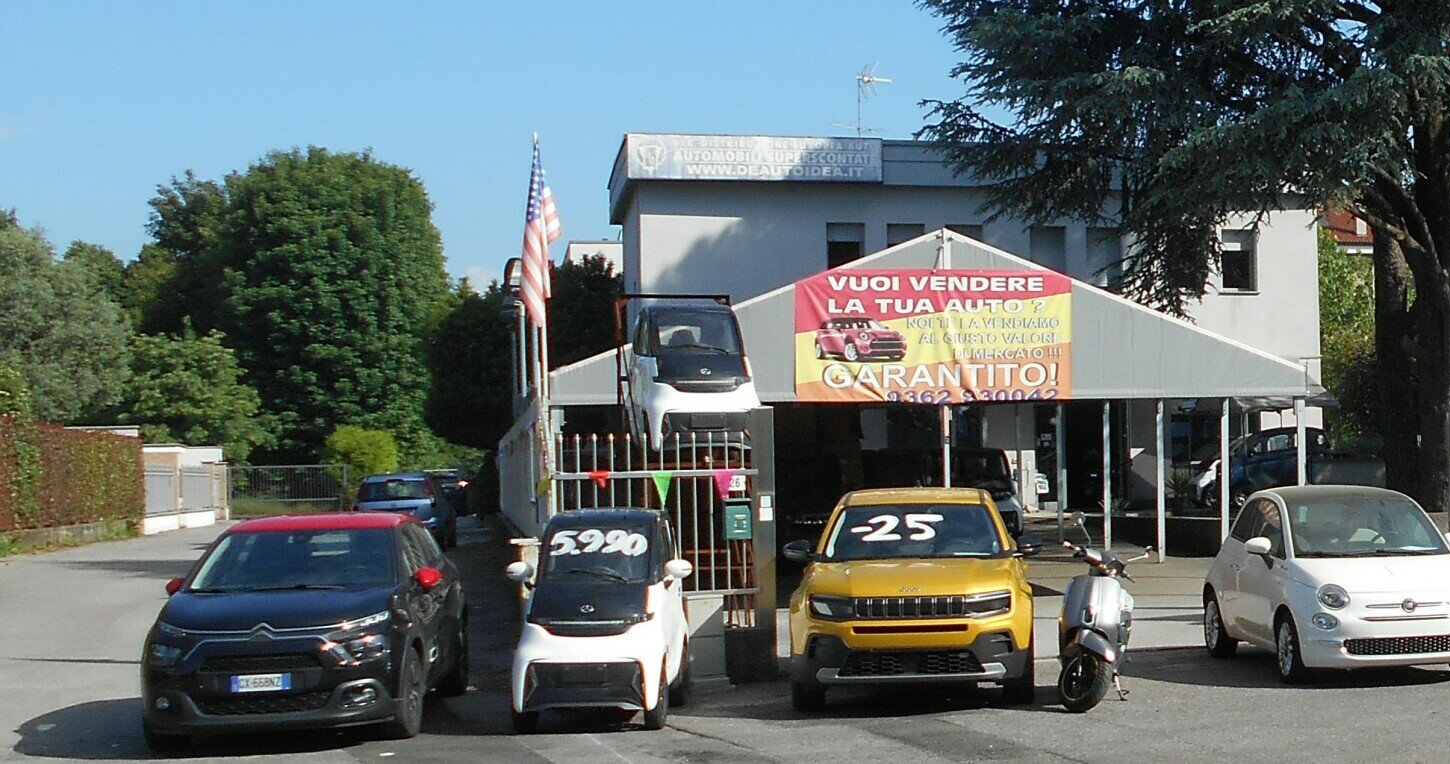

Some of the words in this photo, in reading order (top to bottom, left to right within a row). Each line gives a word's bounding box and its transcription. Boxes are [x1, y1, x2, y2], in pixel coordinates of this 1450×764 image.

[674, 149, 765, 162] AUTOMOBILI
[686, 164, 865, 177] WWW.DEAUTOIDEA.IT
[827, 275, 900, 292] VUOI
[909, 275, 1044, 292] VENDERE
[828, 298, 865, 314] LA
[875, 298, 935, 314] TUA
[943, 298, 1023, 314] AUTO
[906, 317, 934, 329] NOI
[959, 317, 980, 329] LA
[982, 317, 1062, 329] VENDIAMO
[918, 332, 940, 344] AL
[944, 332, 999, 344] GIUSTO
[1001, 332, 1062, 344] VALORE
[972, 347, 1044, 359] MERCATO
[822, 362, 1060, 389] GARANTITO!
[850, 513, 944, 542] -25
